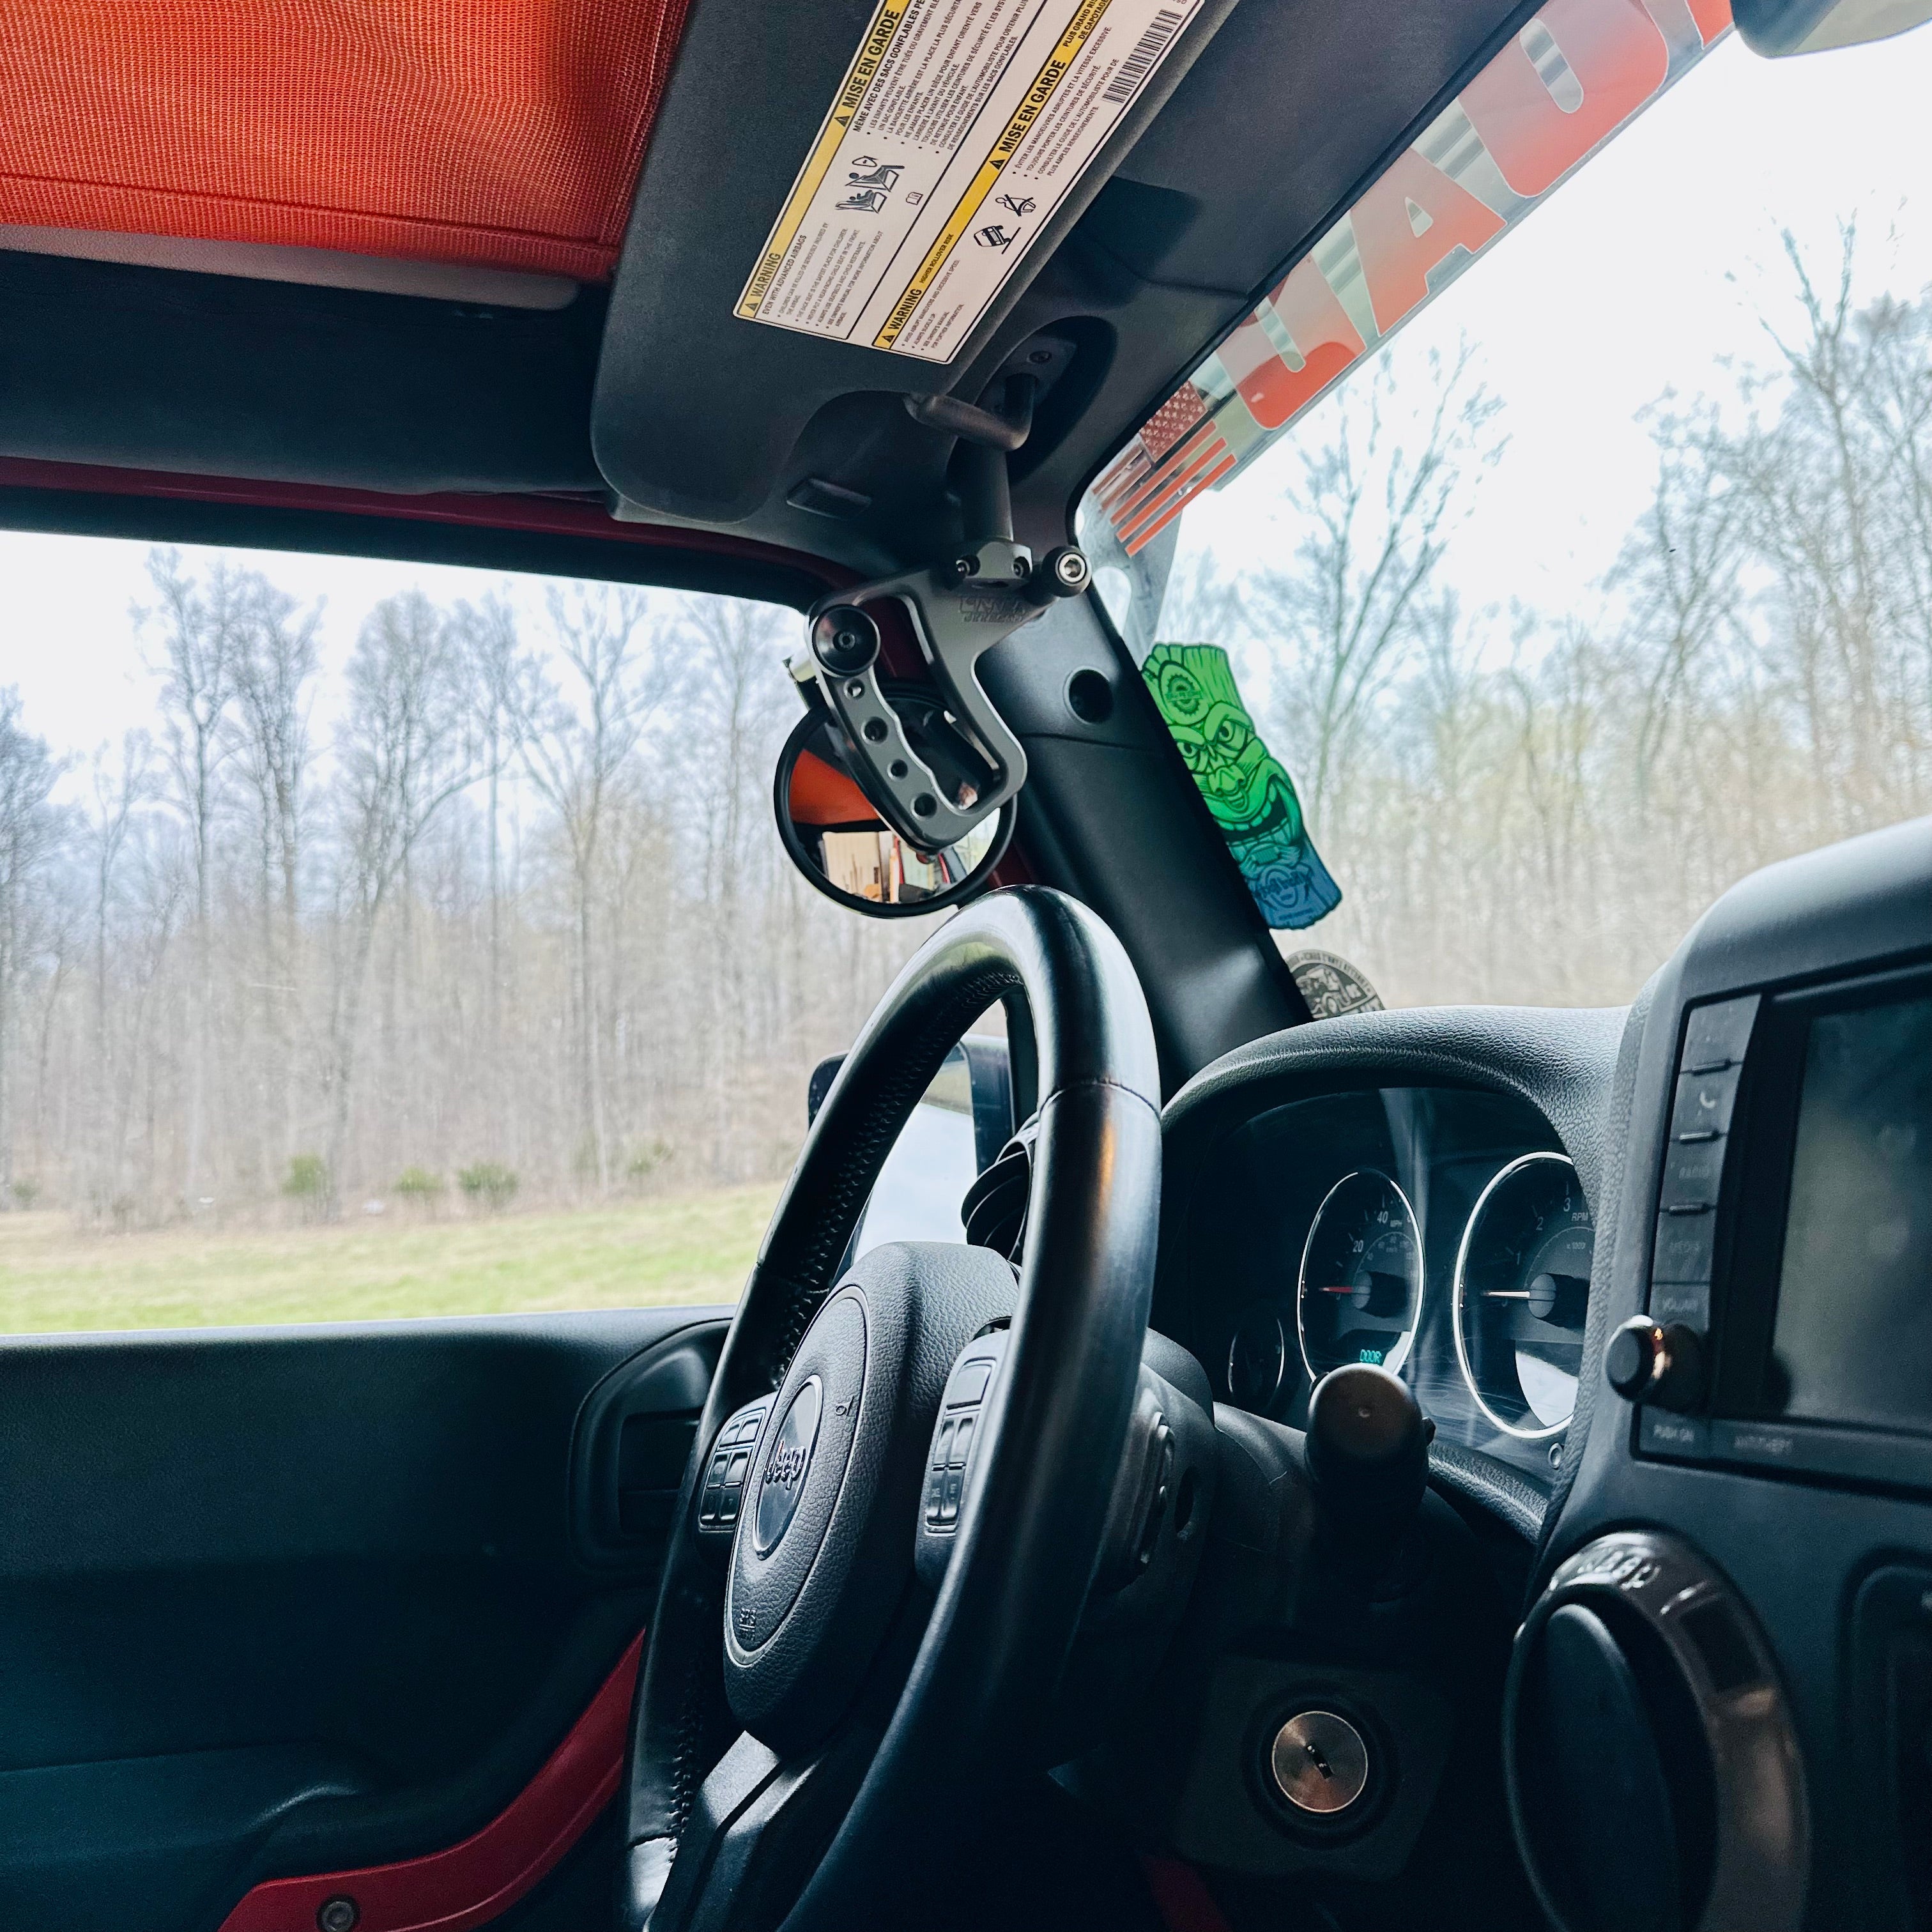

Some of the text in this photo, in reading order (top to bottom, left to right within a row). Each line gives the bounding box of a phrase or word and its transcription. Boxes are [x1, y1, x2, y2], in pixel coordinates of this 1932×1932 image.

[1062, 31, 1077, 47] PLUS
[1073, 9, 1090, 31] GRAND
[1078, 30, 1088, 39] DE
[841, 10, 900, 108] MISE EN GARDE
[853, 111, 869, 132] MÊME
[864, 93, 877, 111] AVEC
[872, 78, 885, 92] DES
[880, 59, 894, 77] SACS
[890, 10, 919, 58] GONFLABLES
[999, 59, 1066, 152] MISE EN GARDE
[750, 253, 781, 296] WARNING
[762, 302, 773, 314] EVEN
[769, 287, 780, 300] WITH
[776, 259, 794, 287] ADVANCED
[790, 234, 806, 258] AIRBAGS
[919, 267, 933, 283] HIGHER
[929, 244, 947, 267] ROLLOVER
[943, 234, 953, 244] RISK
[887, 289, 922, 329] WARNING
[1377, 1211, 1389, 1224] 40
[1535, 1216, 1544, 1230] 2
[1563, 1198, 1570, 1212] 3
[1571, 1213, 1588, 1222] RPM
[1353, 1240, 1363, 1252] 20
[1516, 1252, 1521, 1265] 1
[1360, 1349, 1382, 1363] DOOR
[765, 1440, 806, 1491] Jeep
